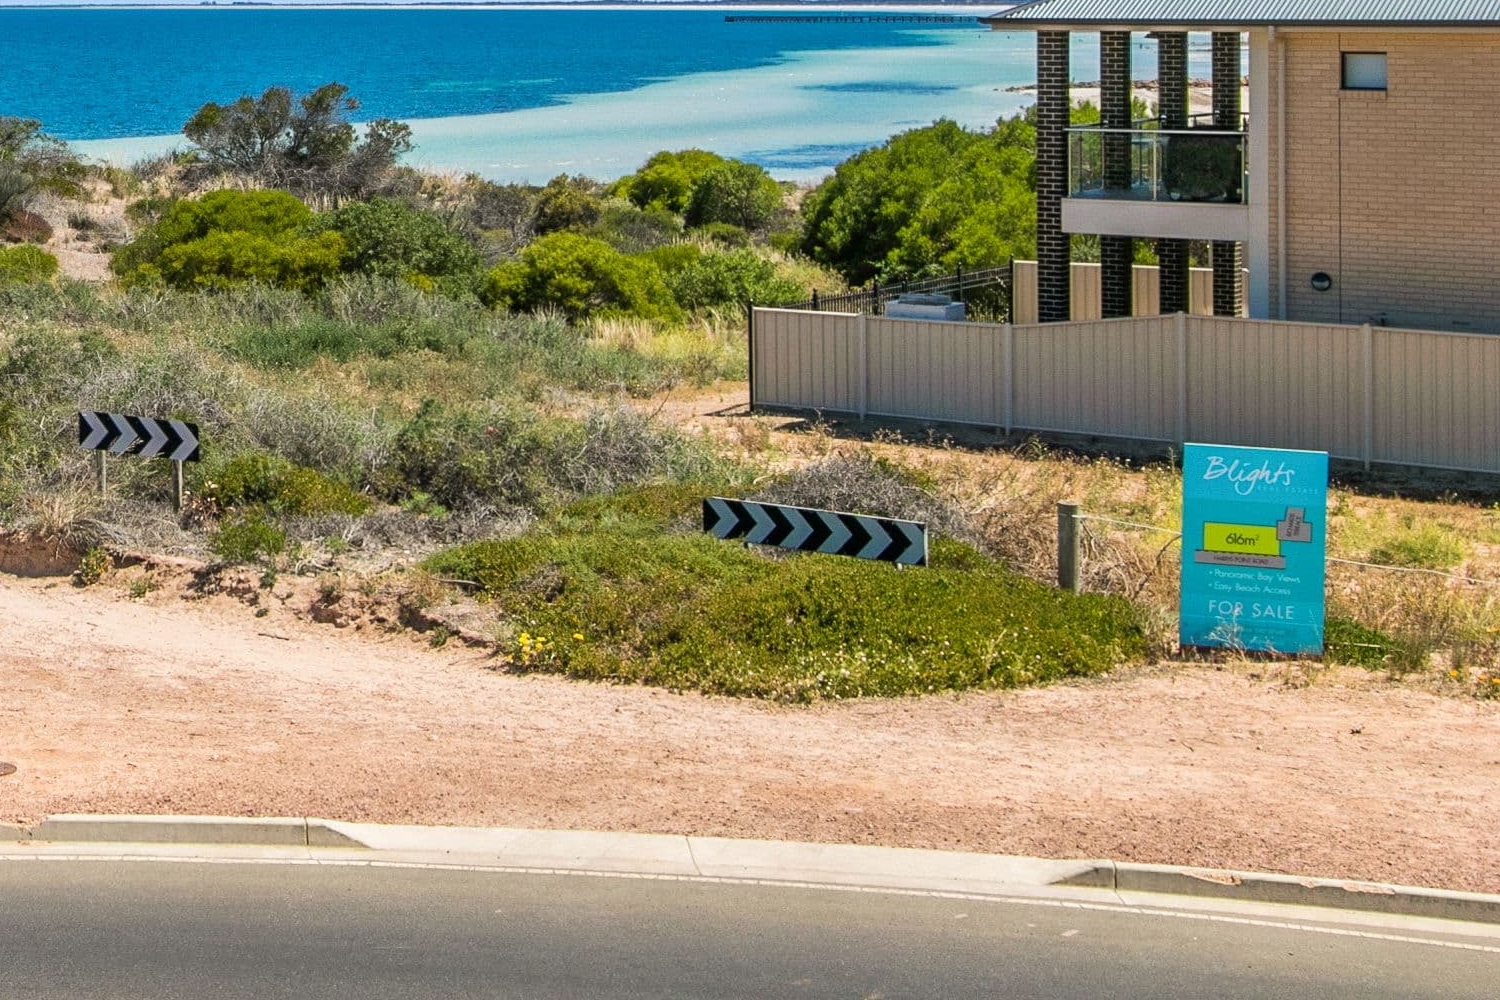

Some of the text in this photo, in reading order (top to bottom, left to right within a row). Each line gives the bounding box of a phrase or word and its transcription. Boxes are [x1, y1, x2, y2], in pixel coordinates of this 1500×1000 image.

[1203, 455, 1296, 496] Blights
[1214, 568, 1301, 584] Panoramic Bay Views
[1214, 581, 1292, 596] Easy Beach Access
[1208, 599, 1295, 620] FOR SALE
